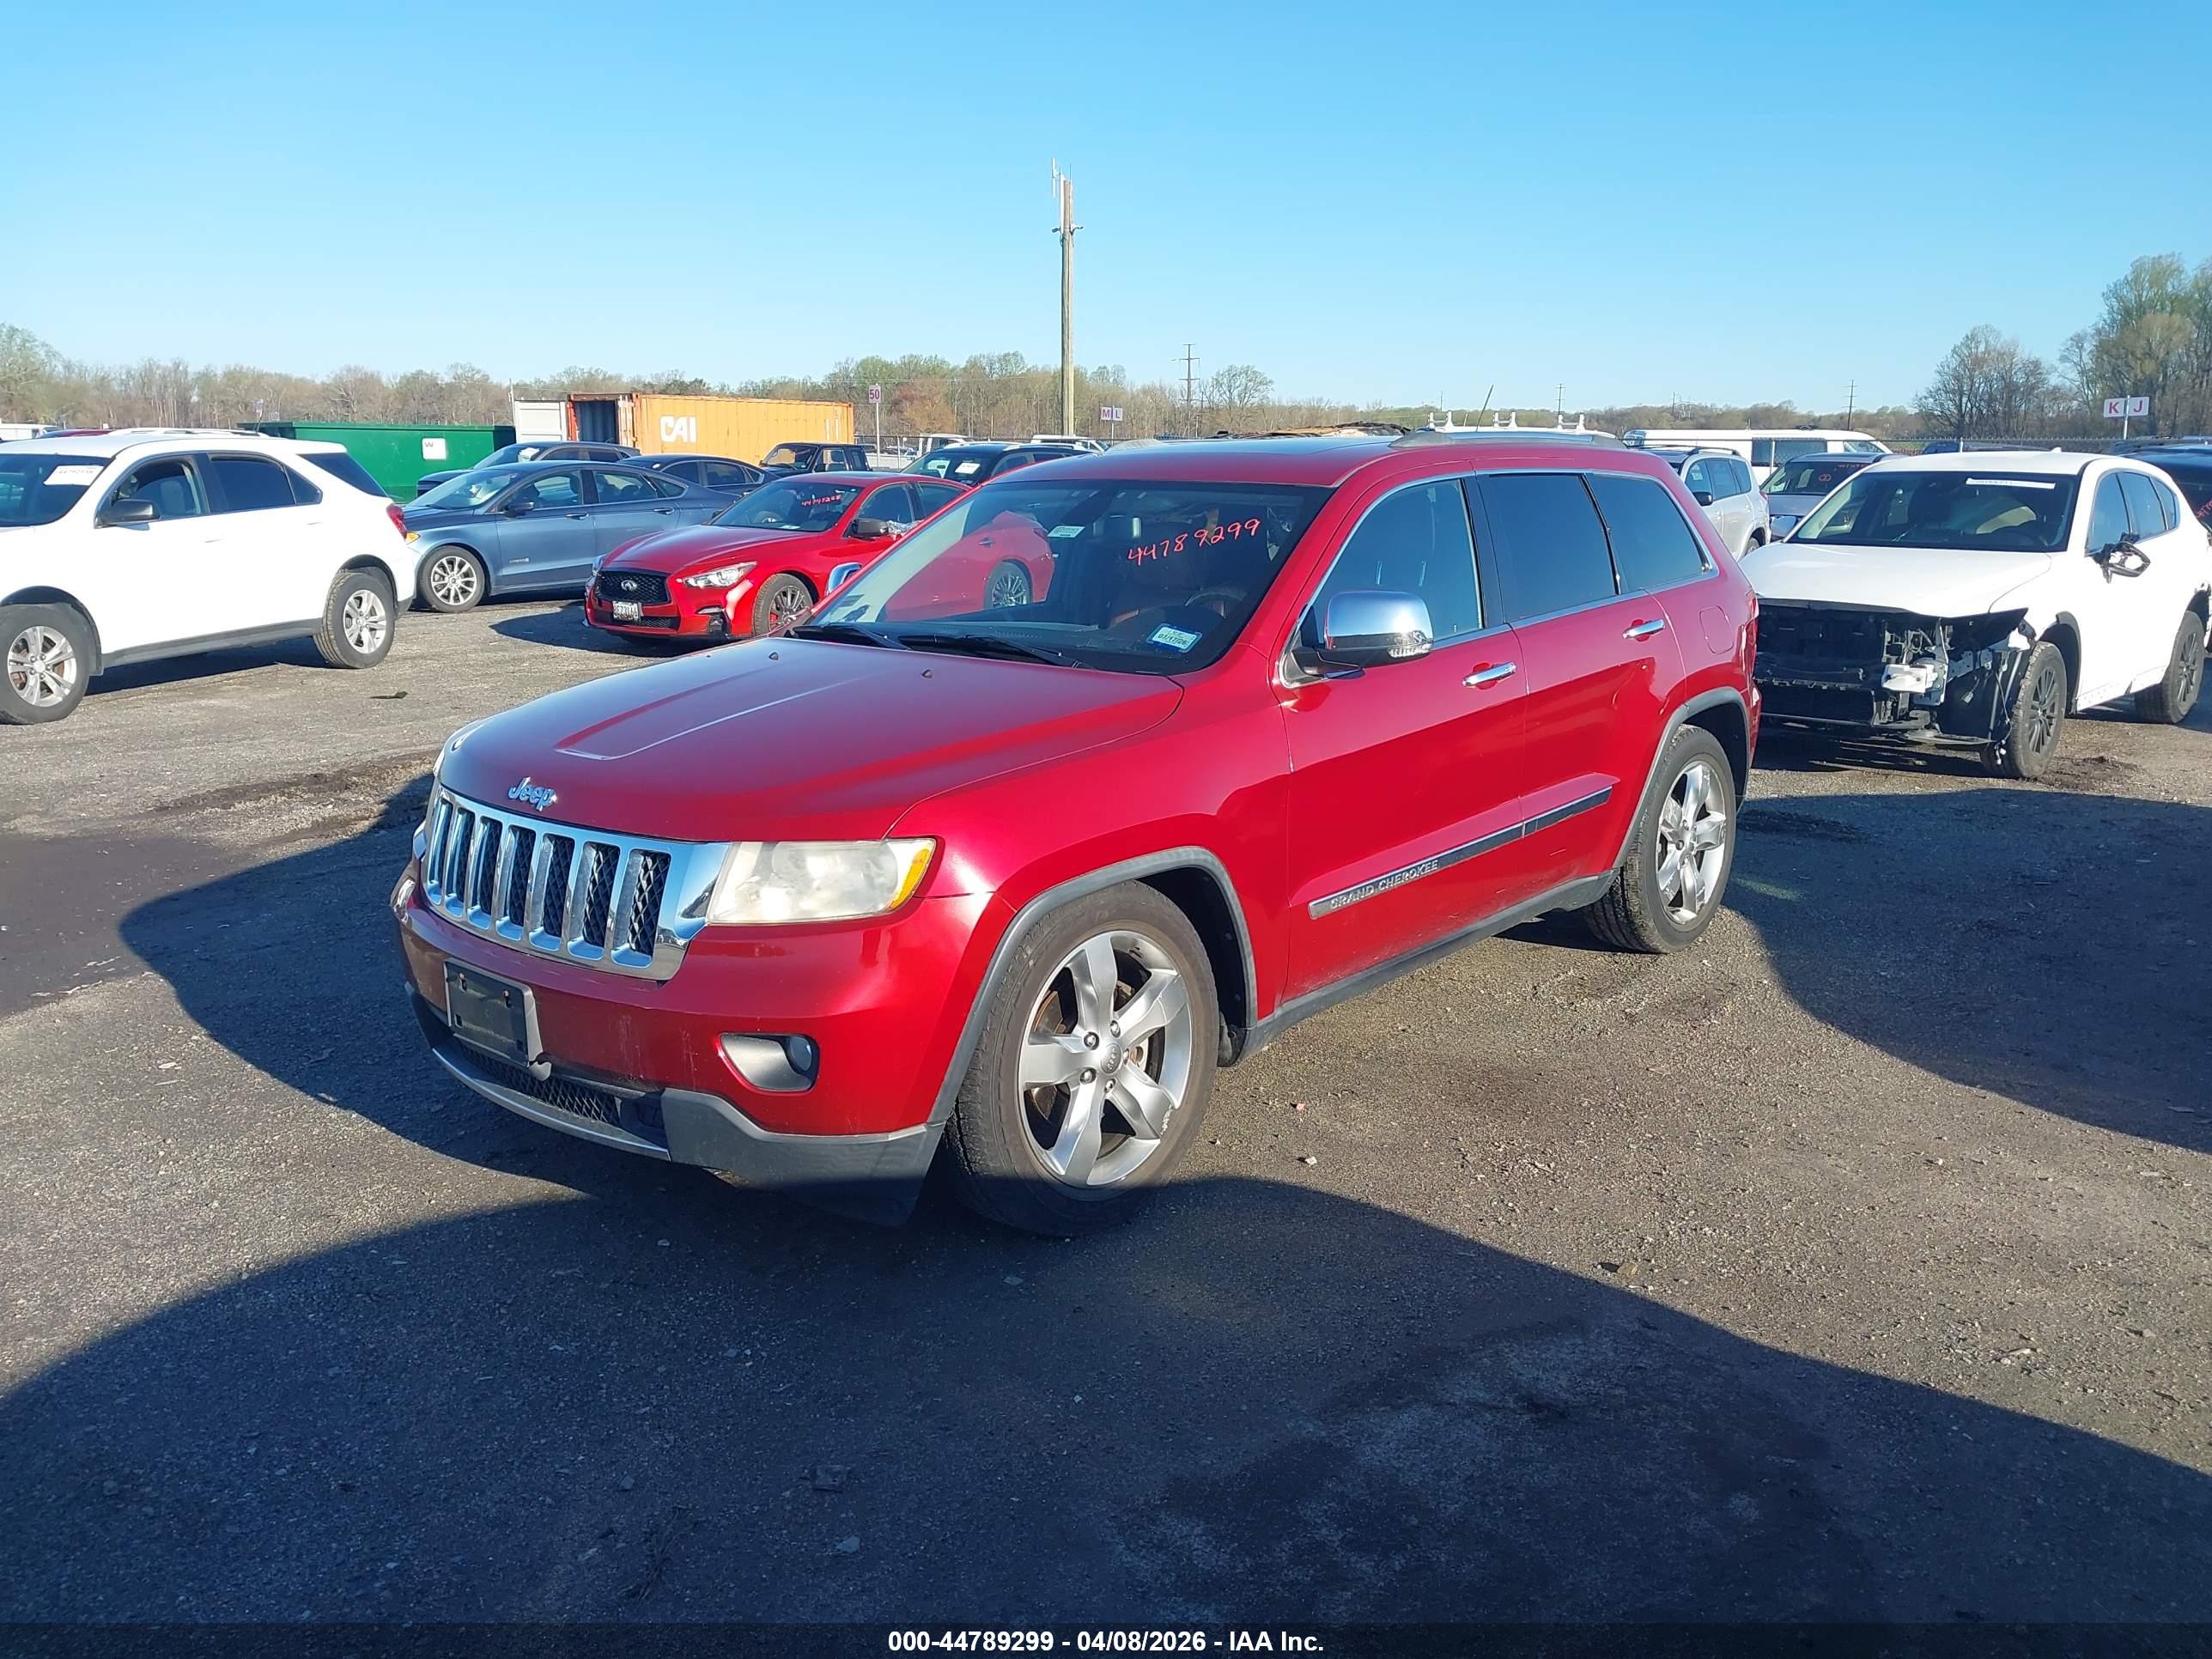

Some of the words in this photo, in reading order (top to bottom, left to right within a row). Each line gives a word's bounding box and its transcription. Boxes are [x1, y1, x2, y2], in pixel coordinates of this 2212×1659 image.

[869, 389, 880, 399] 50
[2109, 402, 2119, 414] K
[2133, 400, 2143, 412] J
[1103, 408, 1110, 418] M
[1115, 409, 1121, 419] L
[659, 416, 697, 443] CAI
[1127, 519, 1261, 567] 44789299
[508, 776, 557, 811] Jeep
[1330, 884, 1375, 909] GRAND
[1377, 860, 1439, 890] CHEROKEE
